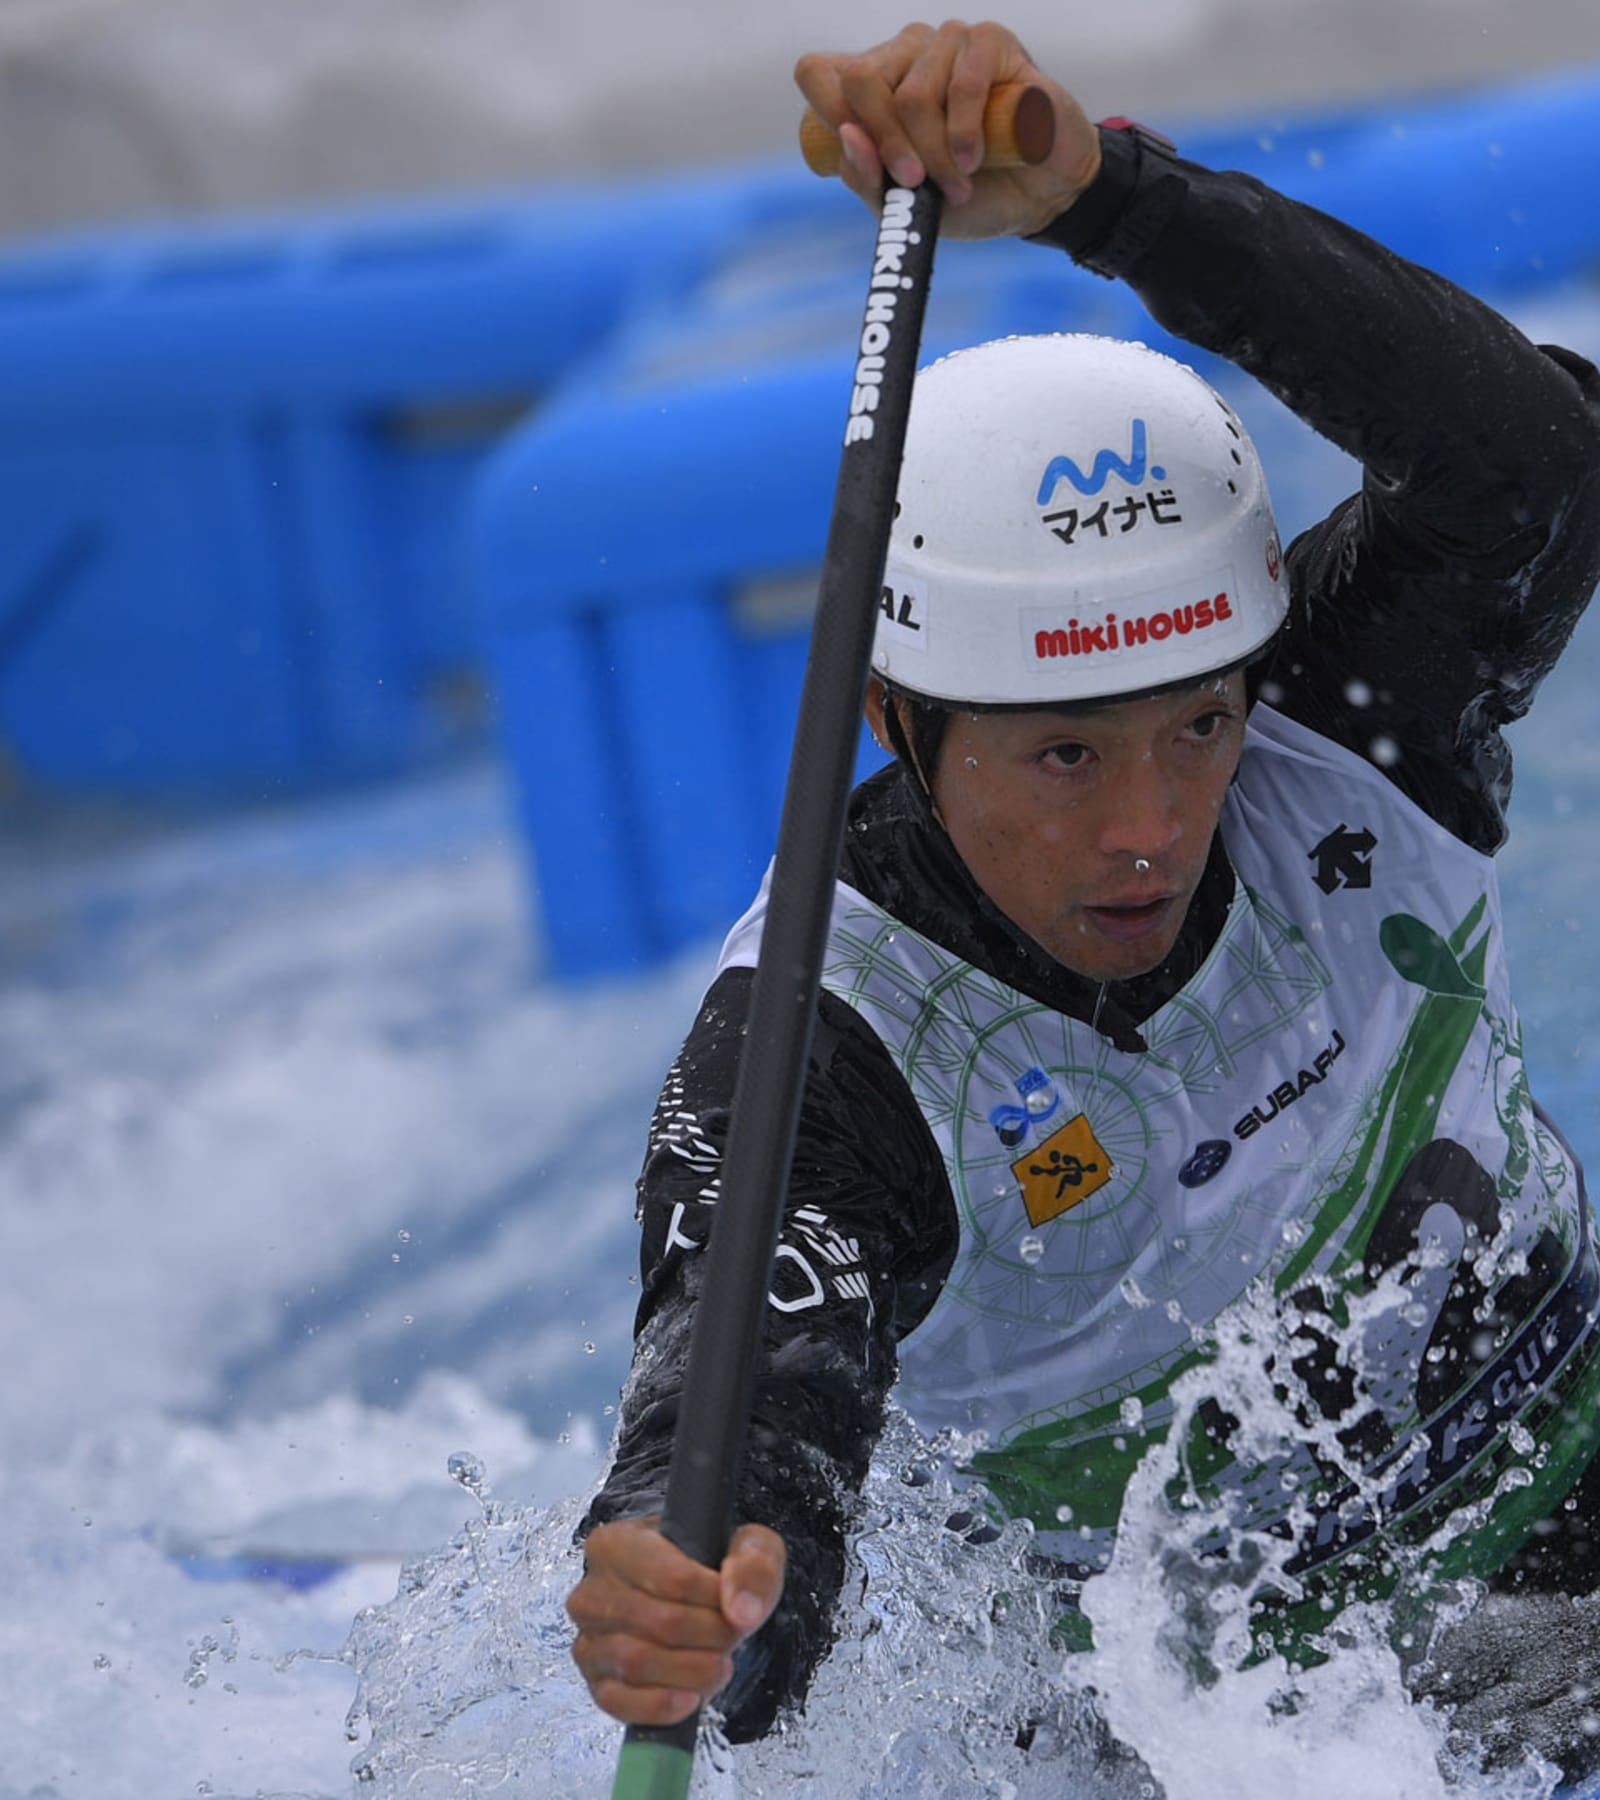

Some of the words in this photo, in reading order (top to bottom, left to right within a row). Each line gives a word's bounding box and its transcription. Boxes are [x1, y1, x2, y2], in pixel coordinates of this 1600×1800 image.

[844, 291, 898, 447] HOUSE
[1042, 489, 1182, 545] マイナビ
[1123, 592, 1233, 647] HOUSE
